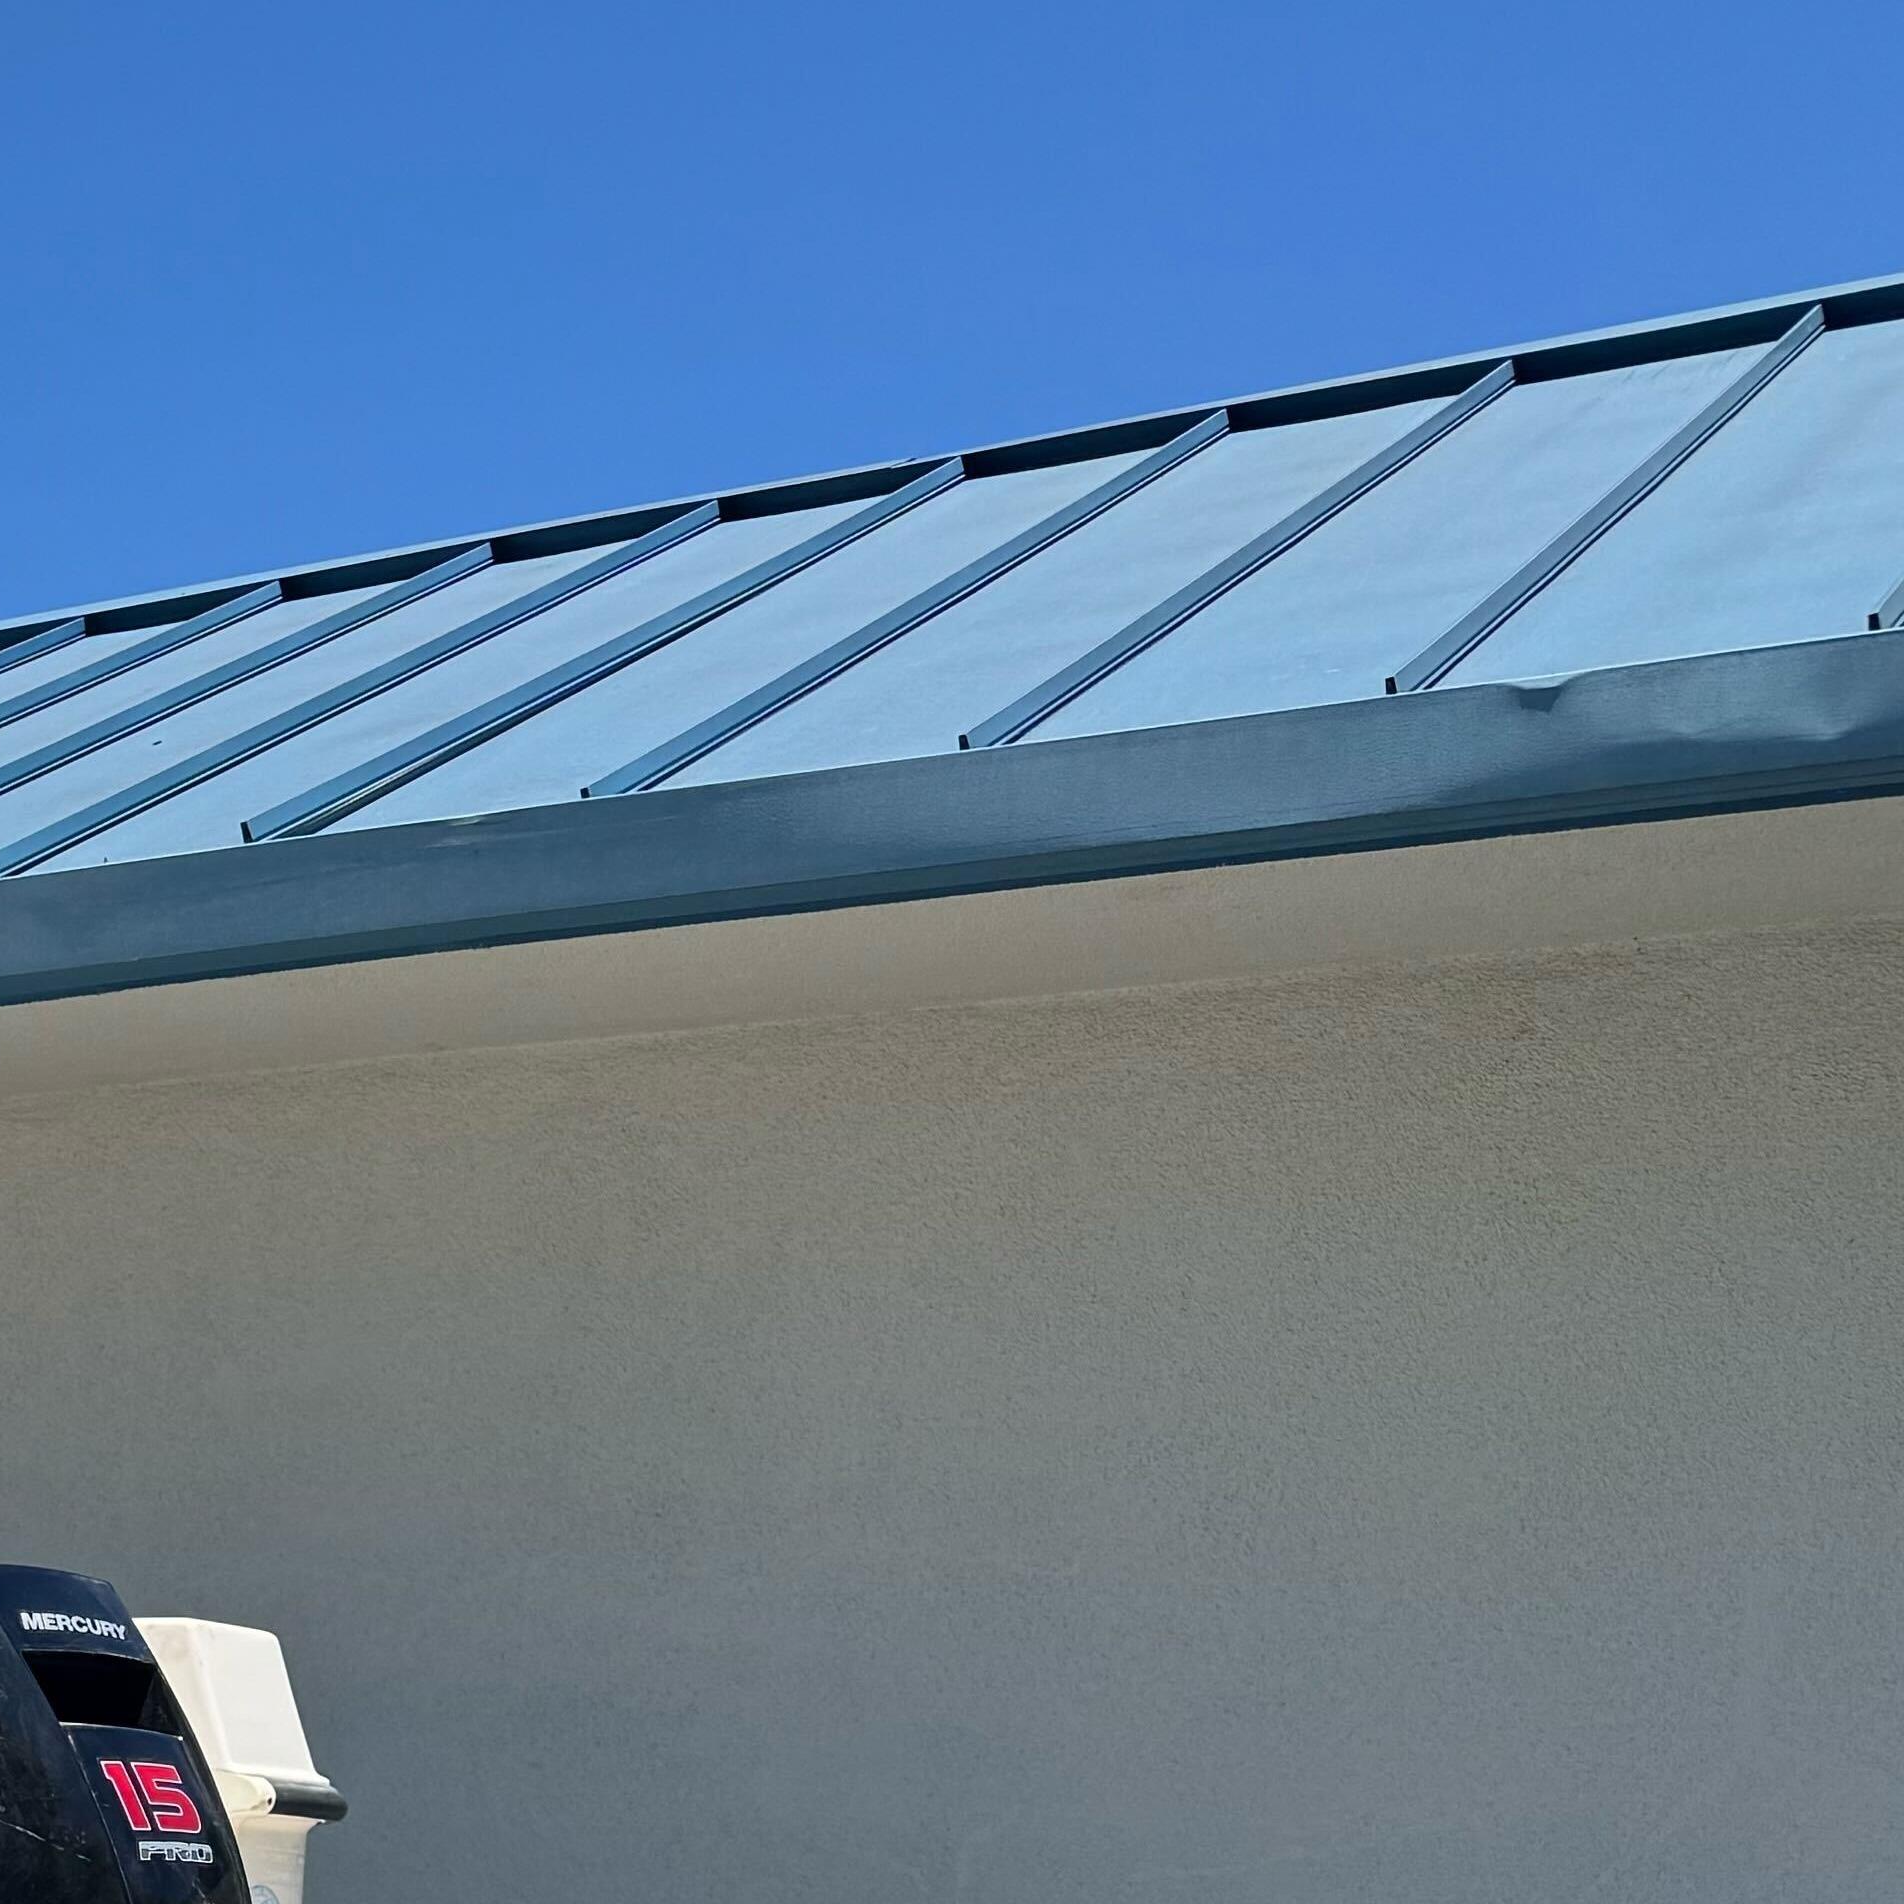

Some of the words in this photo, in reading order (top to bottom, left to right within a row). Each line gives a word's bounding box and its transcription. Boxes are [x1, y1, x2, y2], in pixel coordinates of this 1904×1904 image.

[19, 1612, 126, 1641] MERCURY
[99, 1760, 202, 1834] 15
[138, 1840, 214, 1864] PRO
